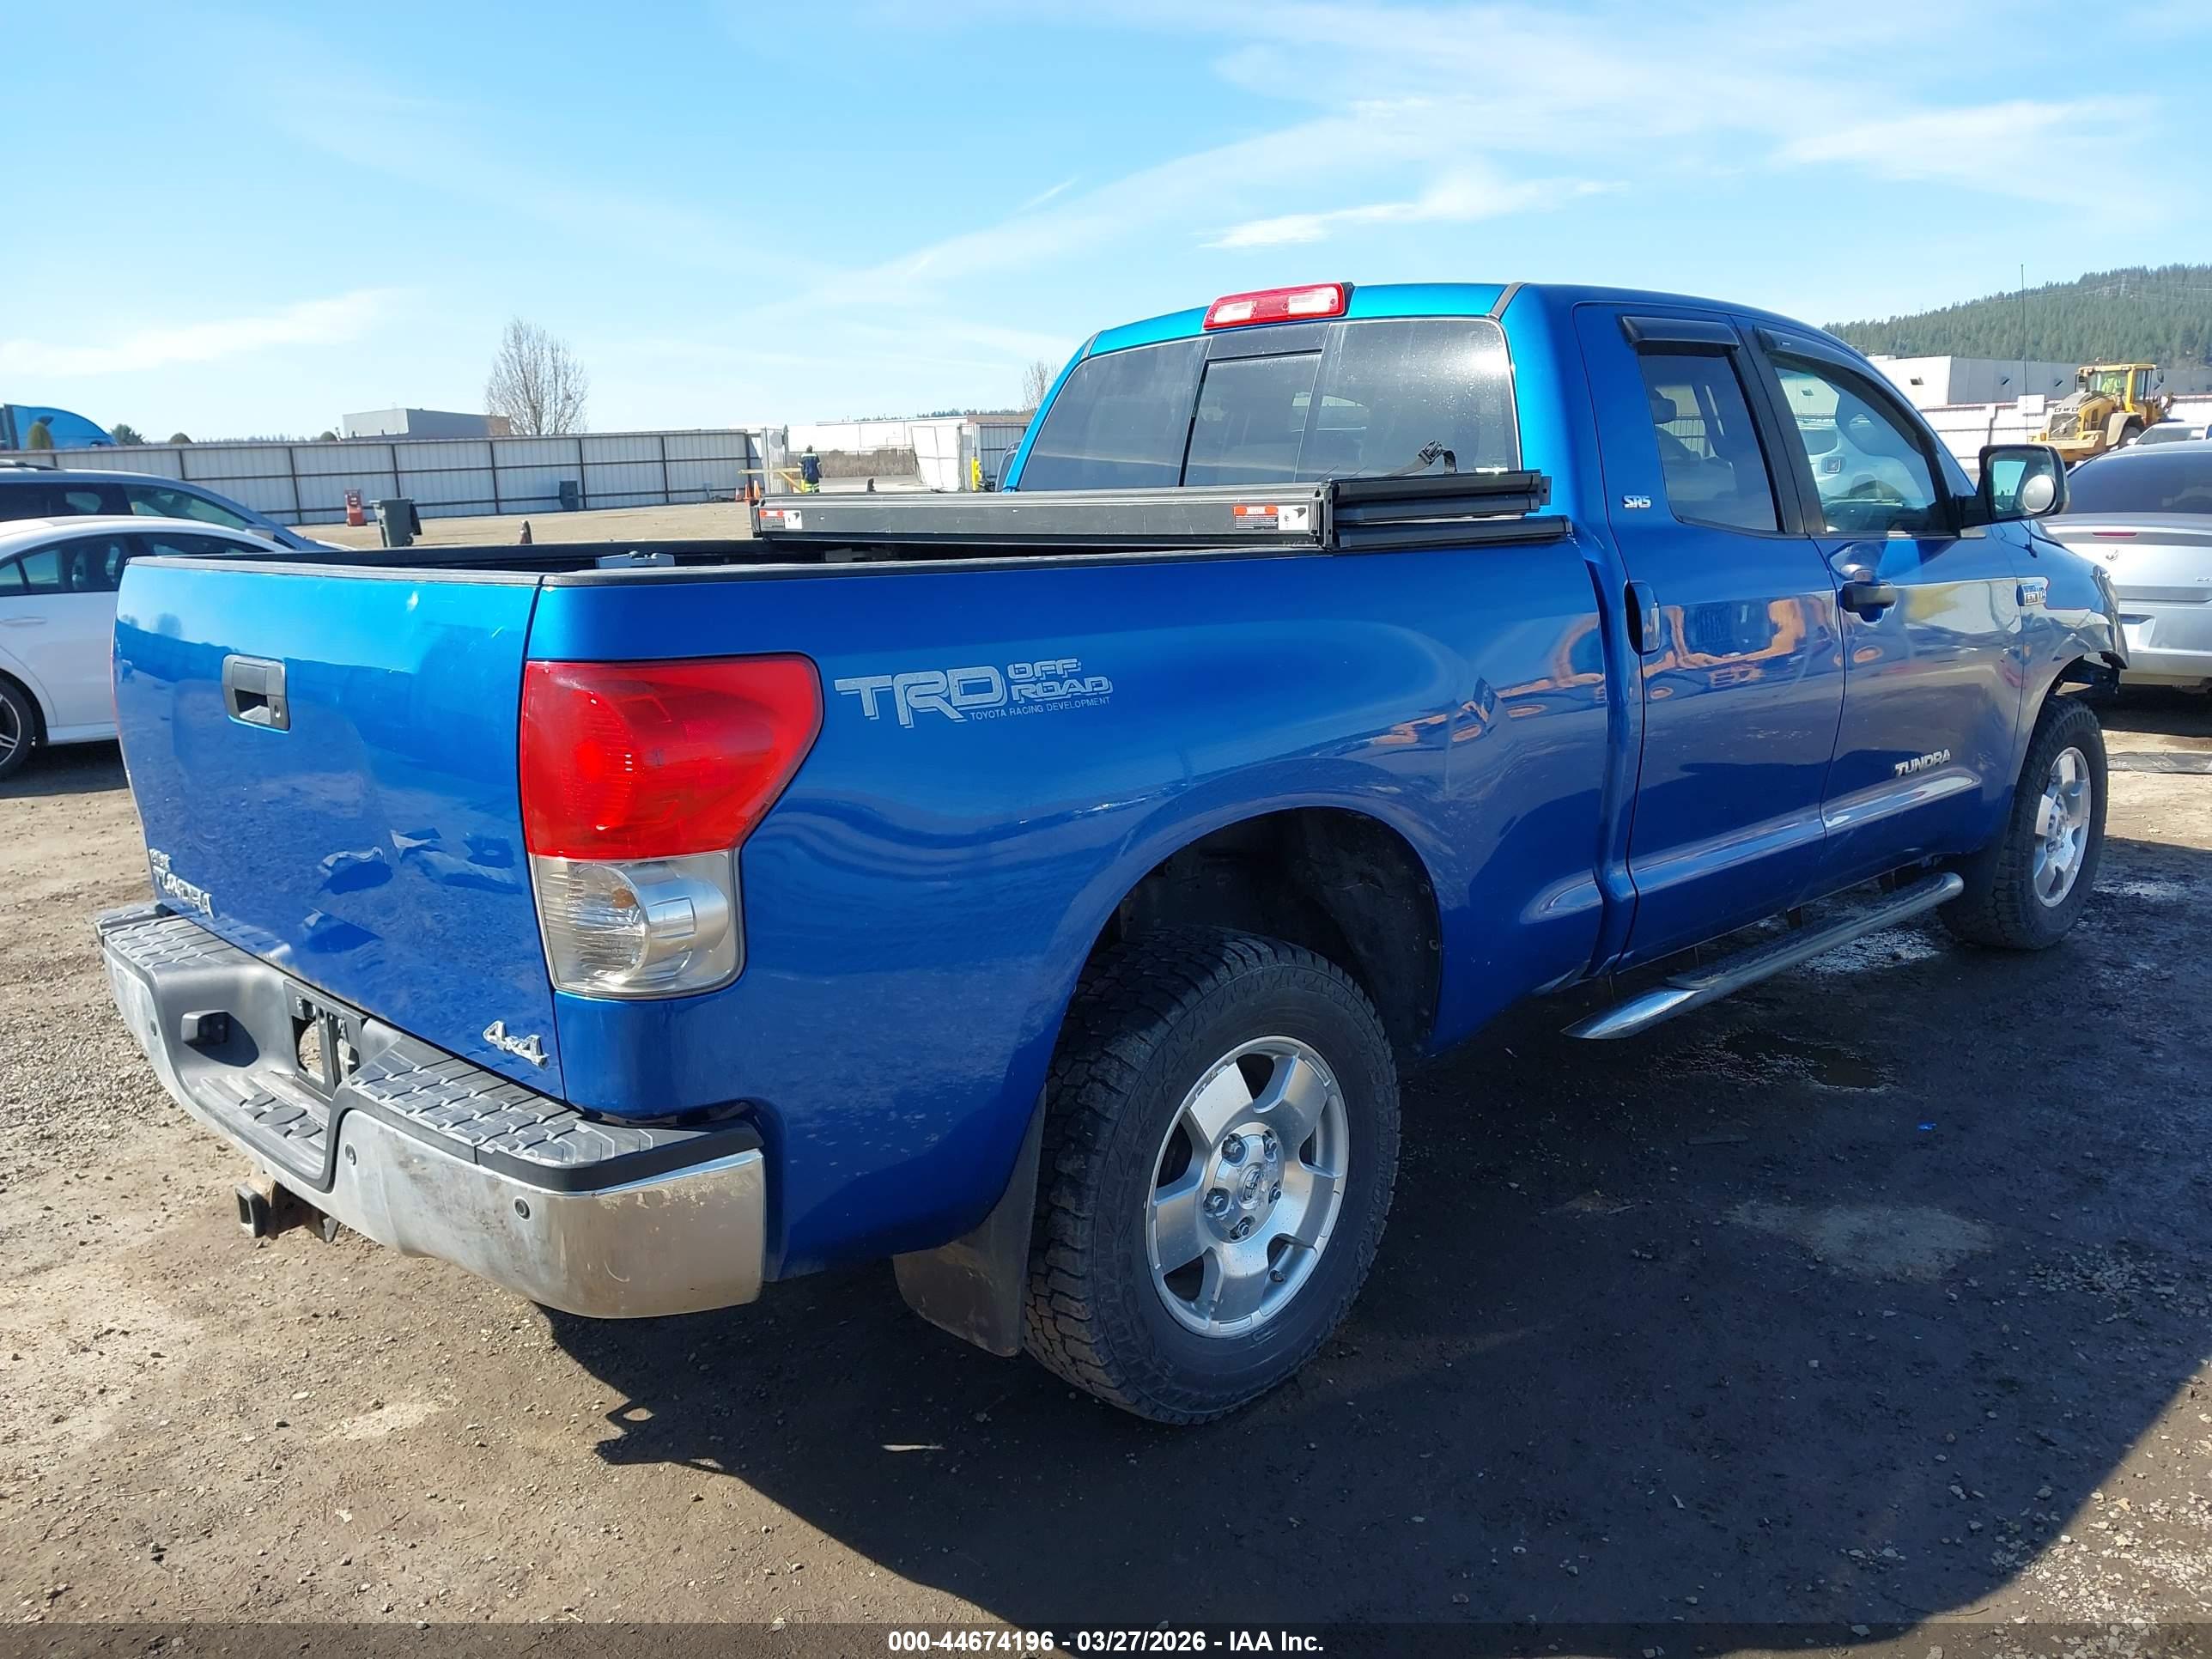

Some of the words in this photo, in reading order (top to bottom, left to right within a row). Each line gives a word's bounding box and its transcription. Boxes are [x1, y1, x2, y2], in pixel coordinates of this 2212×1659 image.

[1007, 658, 1082, 683] OFF
[835, 666, 1008, 728] TRD
[1011, 676, 1114, 704] ROAD
[969, 708, 1007, 721] TOYOTA
[1009, 704, 1044, 717] RACING
[1047, 696, 1111, 712] DEVELOPMENT
[1895, 749, 1951, 777] TUNDRA
